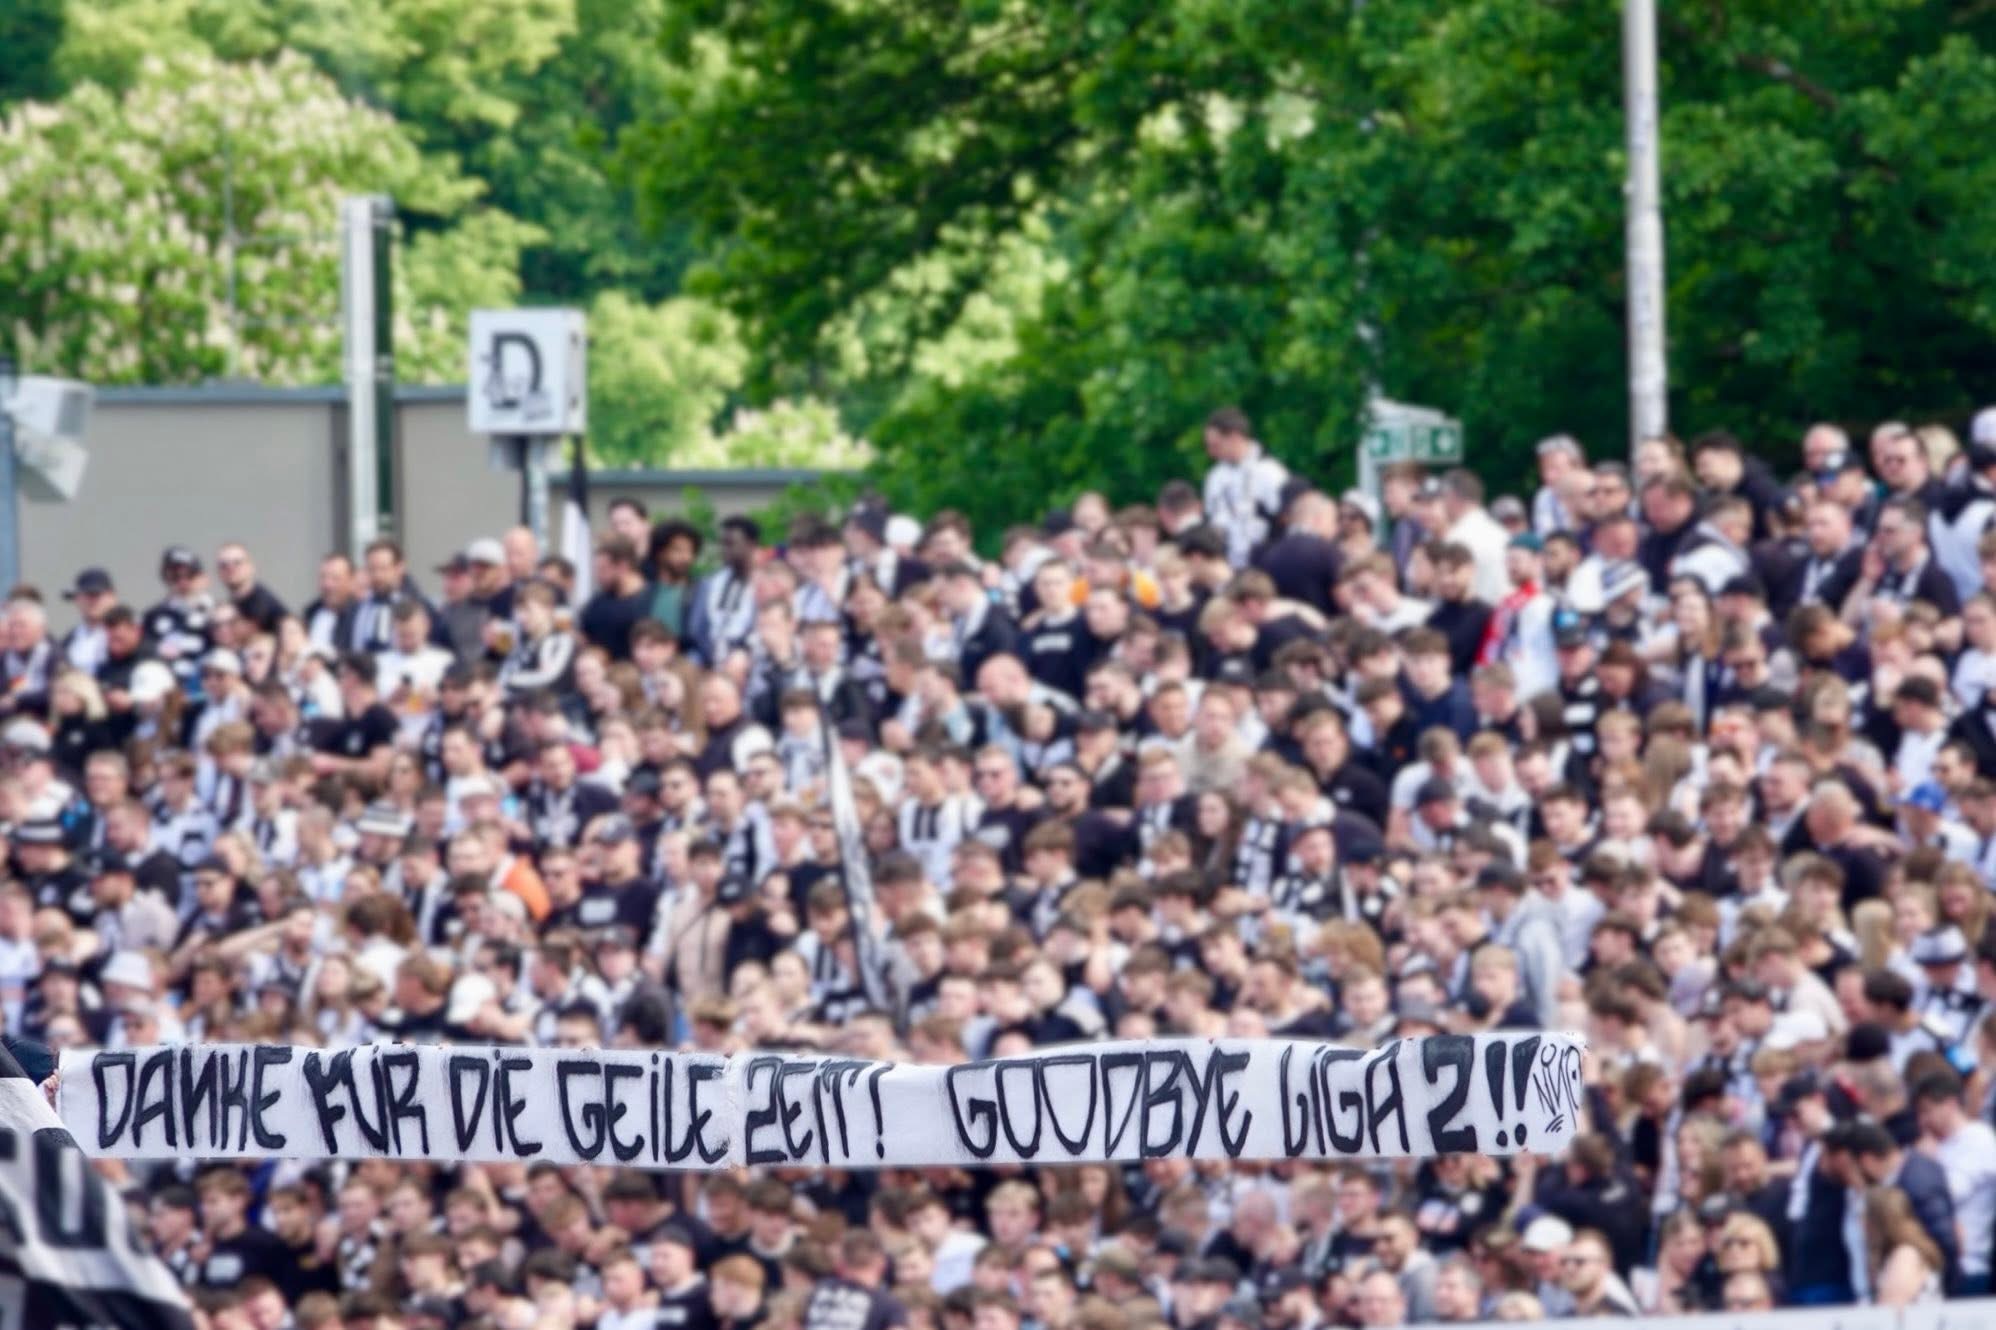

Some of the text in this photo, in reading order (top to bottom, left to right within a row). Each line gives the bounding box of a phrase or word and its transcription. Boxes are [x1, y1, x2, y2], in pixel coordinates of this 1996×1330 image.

[491, 331, 543, 411] D
[93, 1046, 292, 1151] DANKE
[947, 1046, 1252, 1158] GOODBYE
